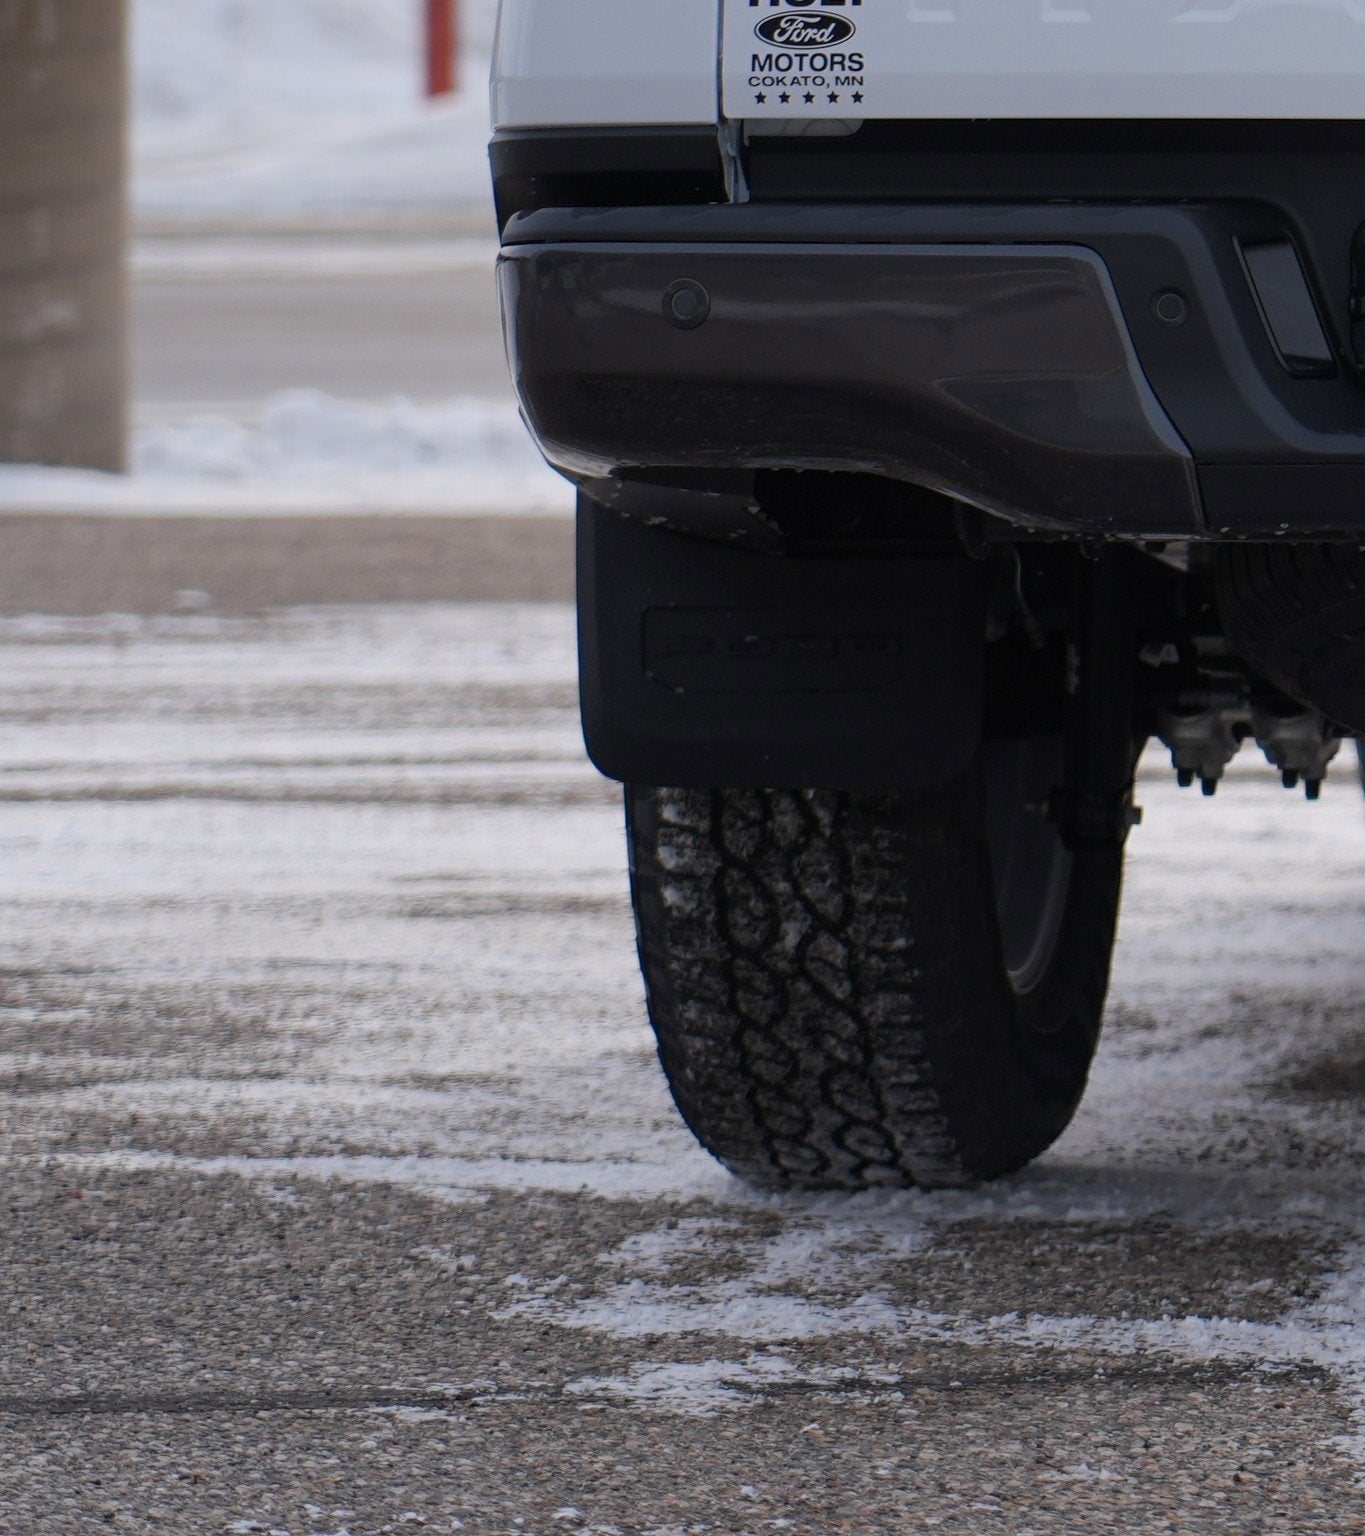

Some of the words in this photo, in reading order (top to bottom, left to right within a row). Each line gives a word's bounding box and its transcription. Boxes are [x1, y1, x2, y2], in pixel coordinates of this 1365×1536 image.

[773, 15, 836, 43] Ford
[751, 52, 865, 72] MOTORS
[748, 75, 830, 89] COKATO,
[834, 75, 864, 86] MN
